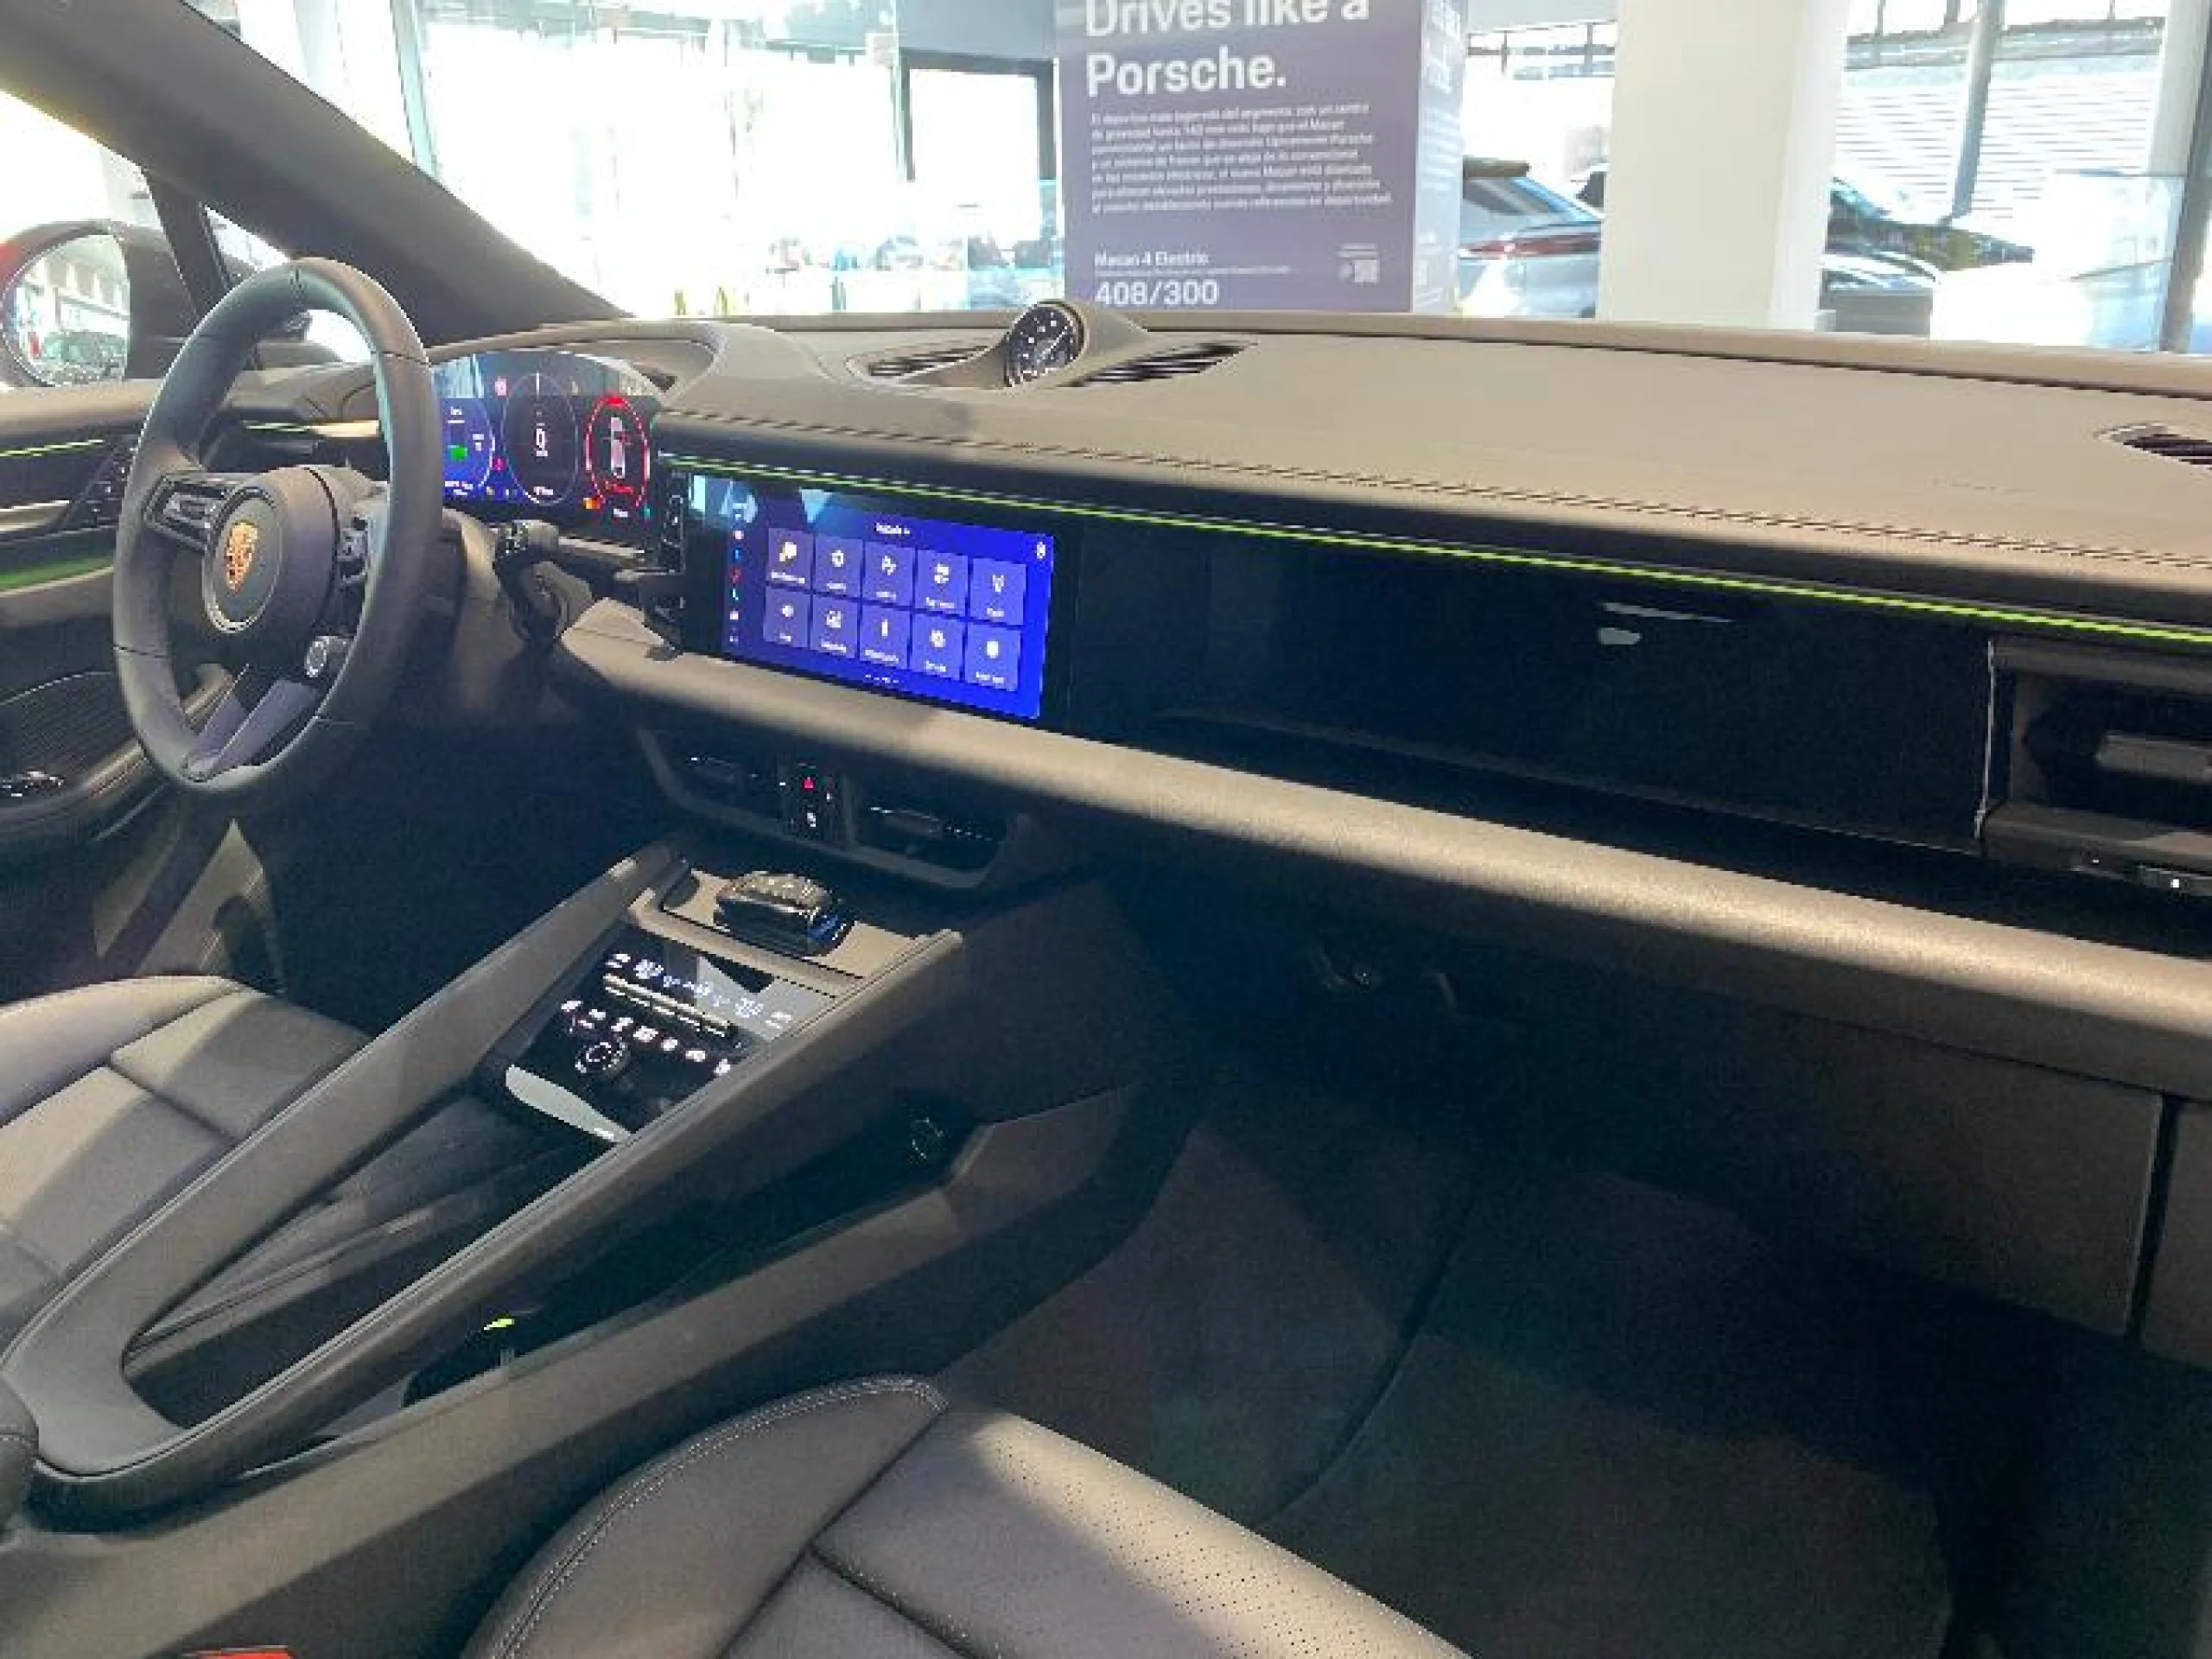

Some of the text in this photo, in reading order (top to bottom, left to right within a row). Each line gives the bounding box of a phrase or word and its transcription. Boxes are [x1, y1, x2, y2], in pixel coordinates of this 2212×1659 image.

[1086, 0, 1370, 37] Drives like a
[1087, 46, 1287, 97] Porsche.
[1095, 279, 1220, 305] 408/300
